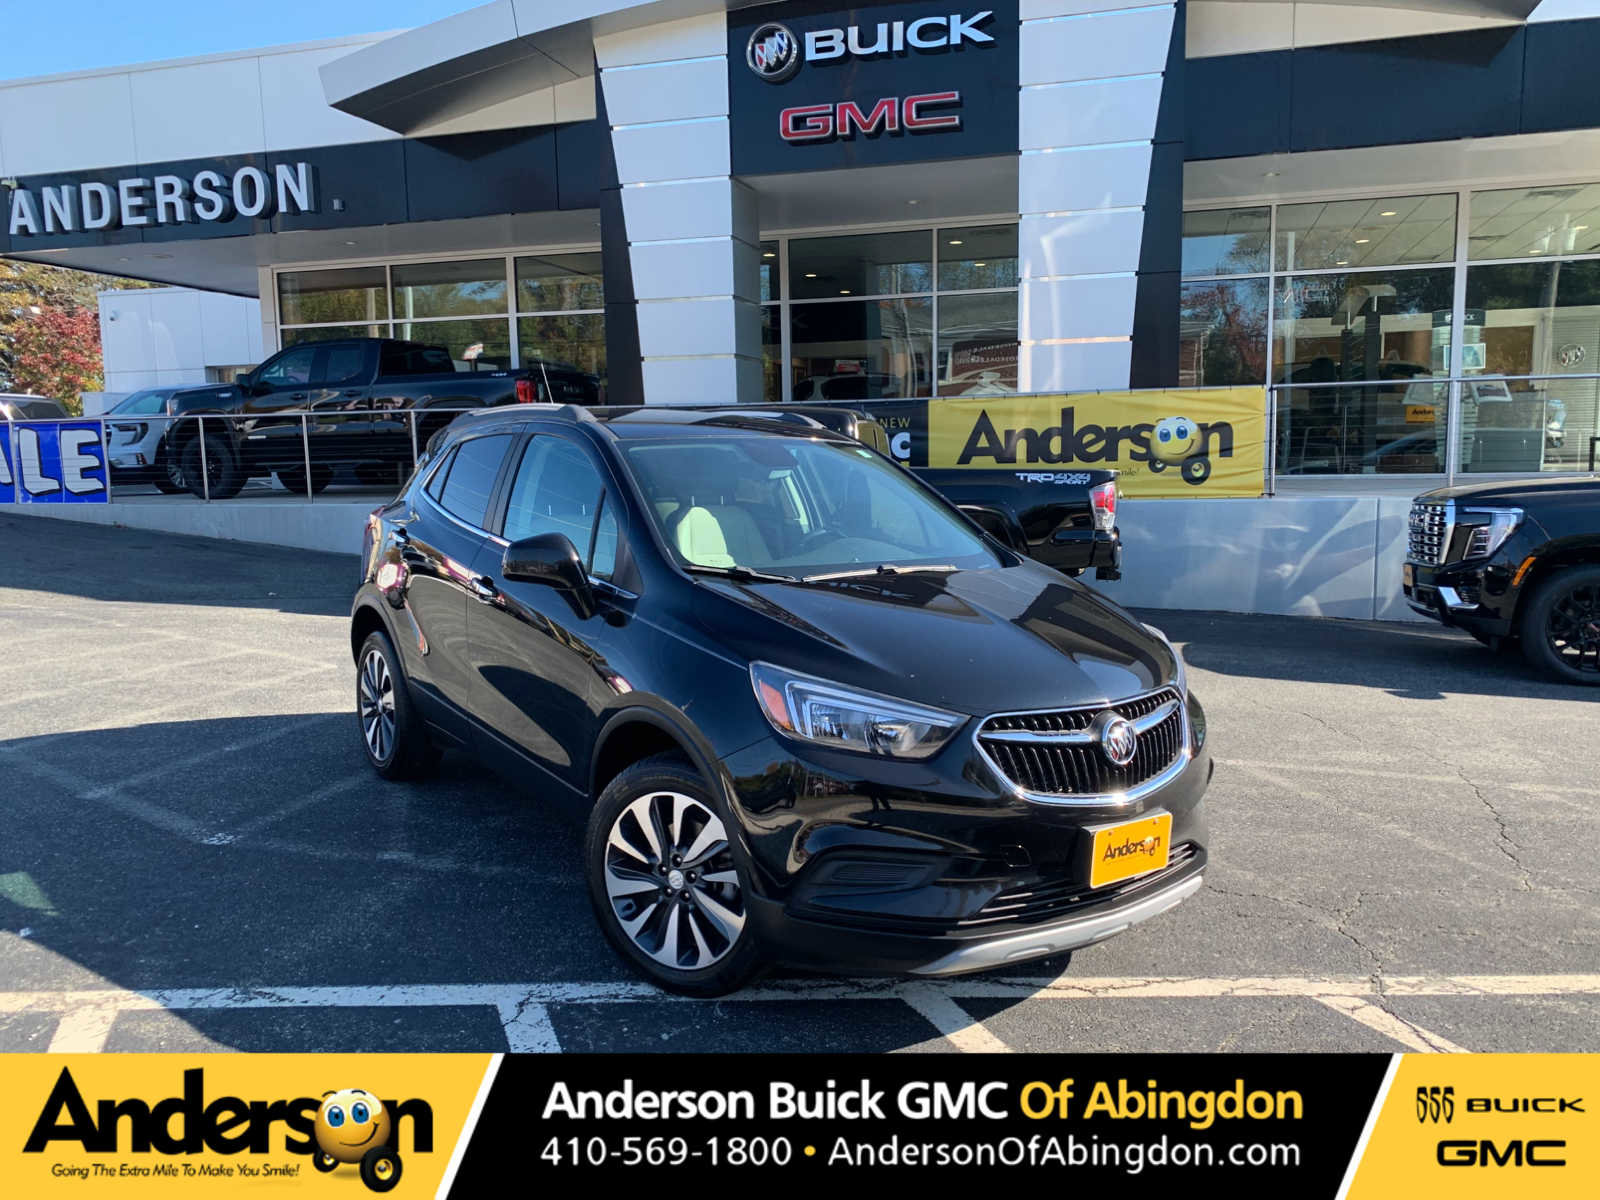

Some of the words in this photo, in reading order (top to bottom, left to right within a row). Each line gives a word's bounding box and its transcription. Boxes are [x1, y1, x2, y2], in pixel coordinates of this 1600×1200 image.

[805, 11, 995, 61] BUICK
[780, 91, 960, 141] GMC
[9, 162, 313, 234] ANDERSON
